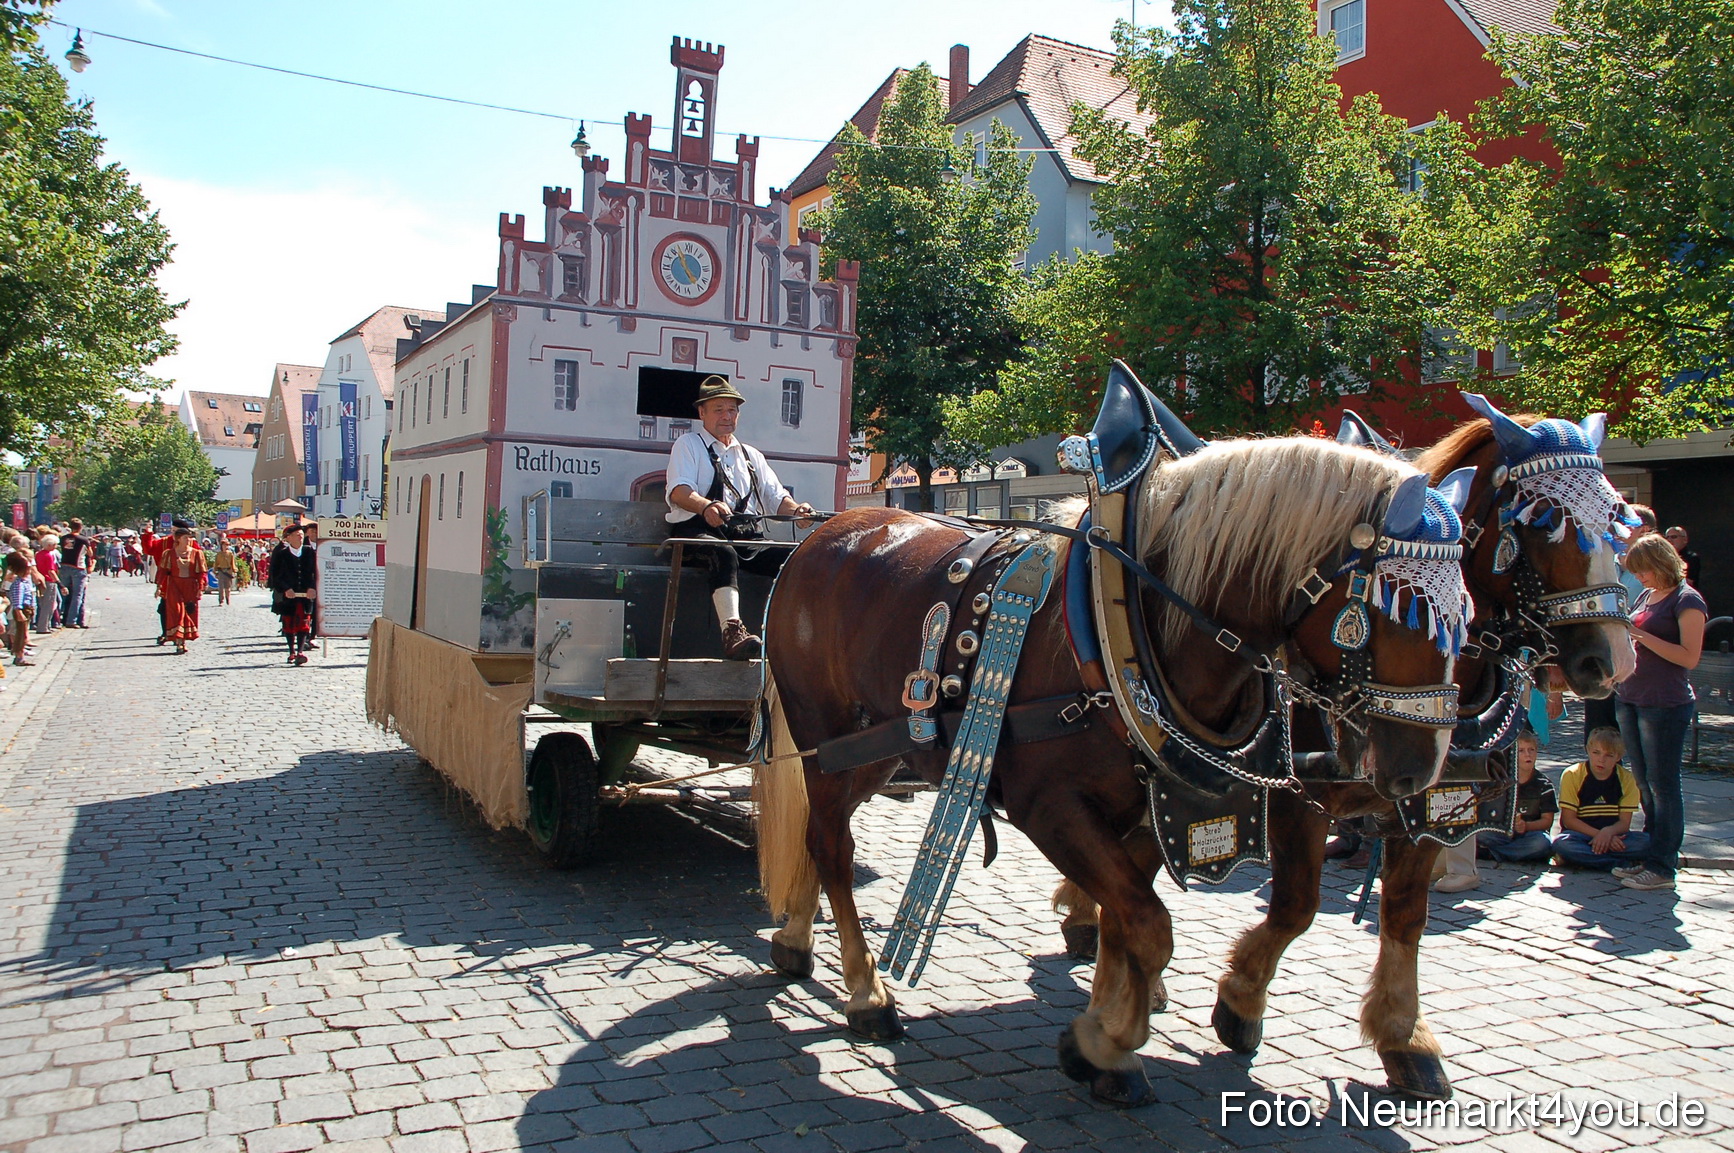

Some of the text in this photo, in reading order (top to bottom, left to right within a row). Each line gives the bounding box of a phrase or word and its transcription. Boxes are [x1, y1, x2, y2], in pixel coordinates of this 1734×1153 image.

[513, 446, 601, 475] Rathaus
[335, 521, 376, 529] 700 Jahre
[328, 530, 382, 539] Stadt Hemau
[1204, 827, 1221, 835] Streb
[1196, 834, 1230, 847] Holzrücker
